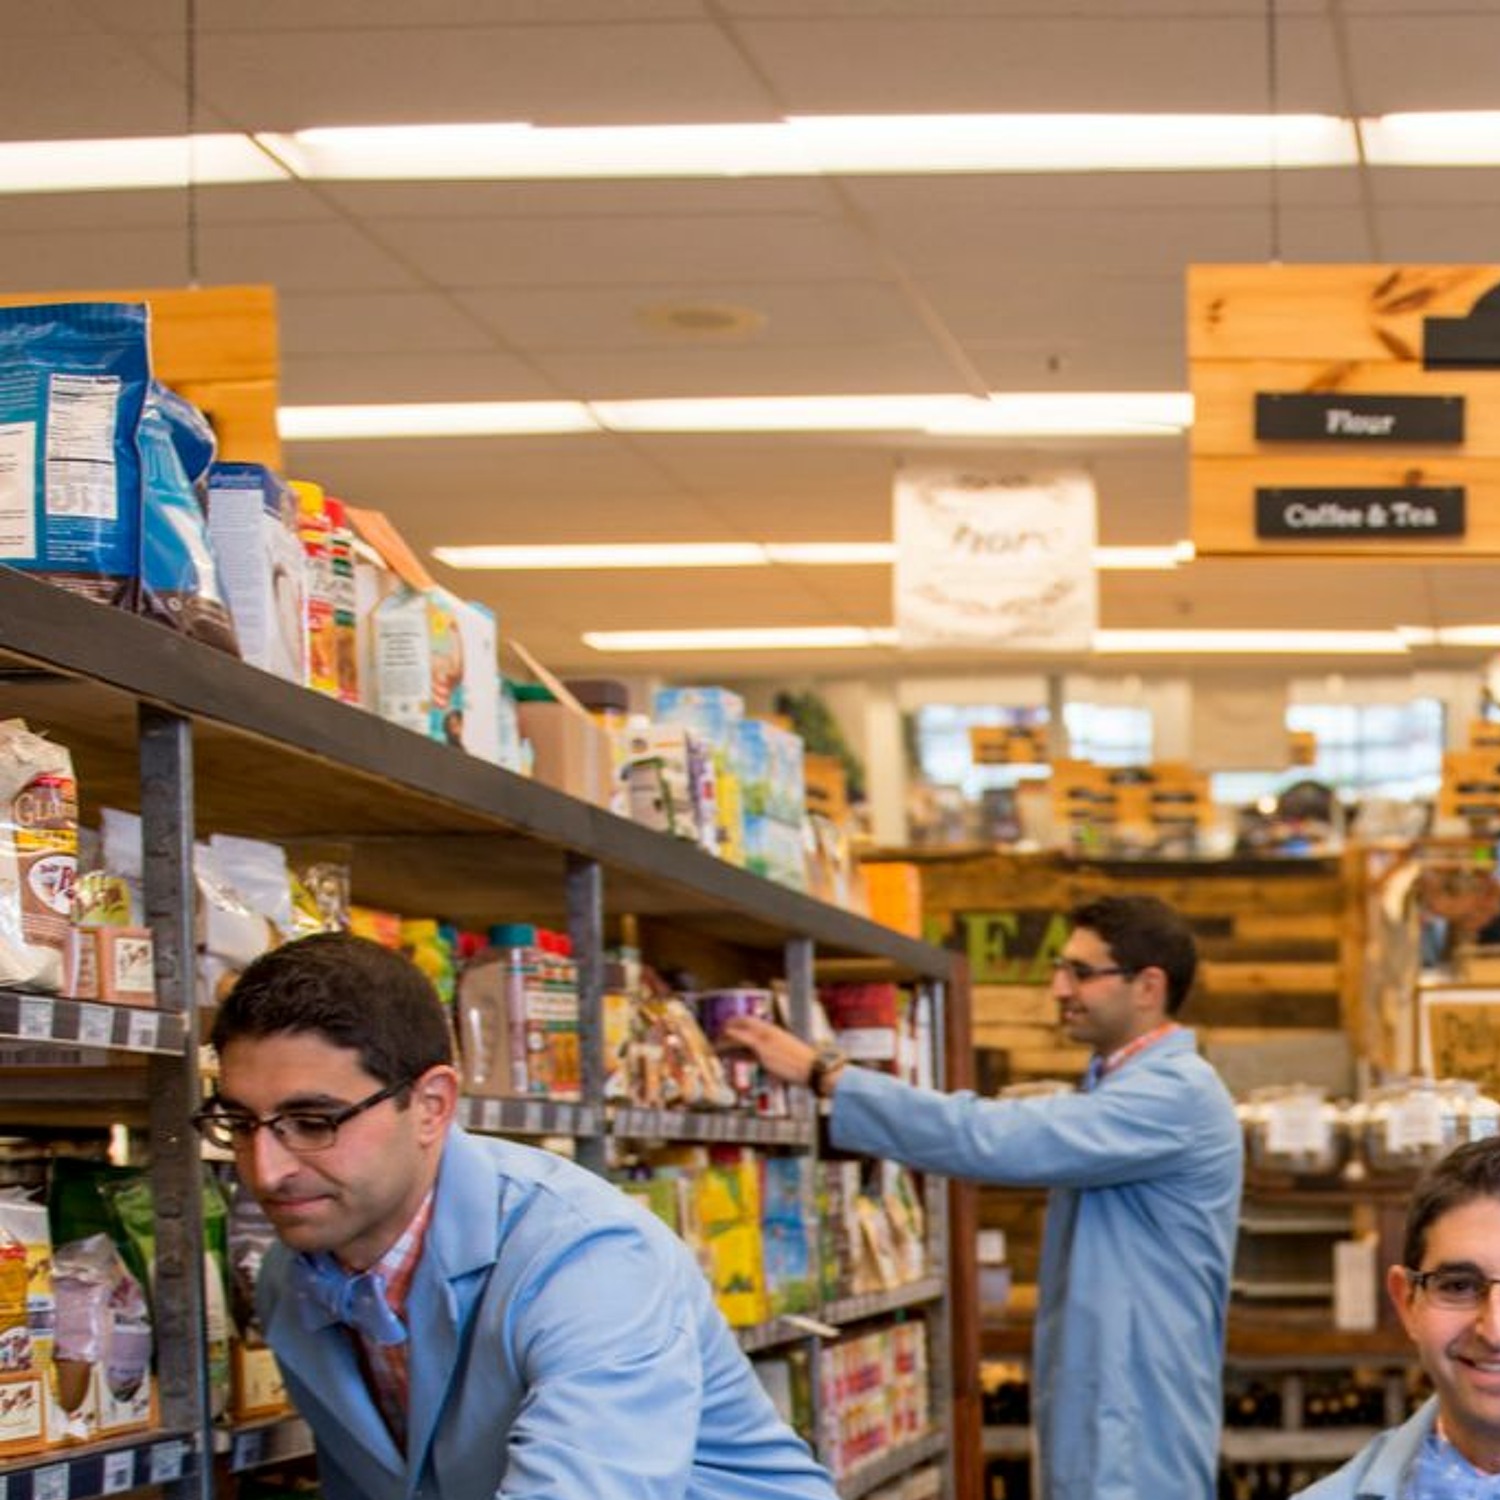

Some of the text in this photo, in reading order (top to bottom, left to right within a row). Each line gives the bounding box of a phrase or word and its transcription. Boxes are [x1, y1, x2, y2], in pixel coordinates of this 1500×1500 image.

[1326, 409, 1395, 435] Flour
[1284, 503, 1437, 528] Coffee & Tea
